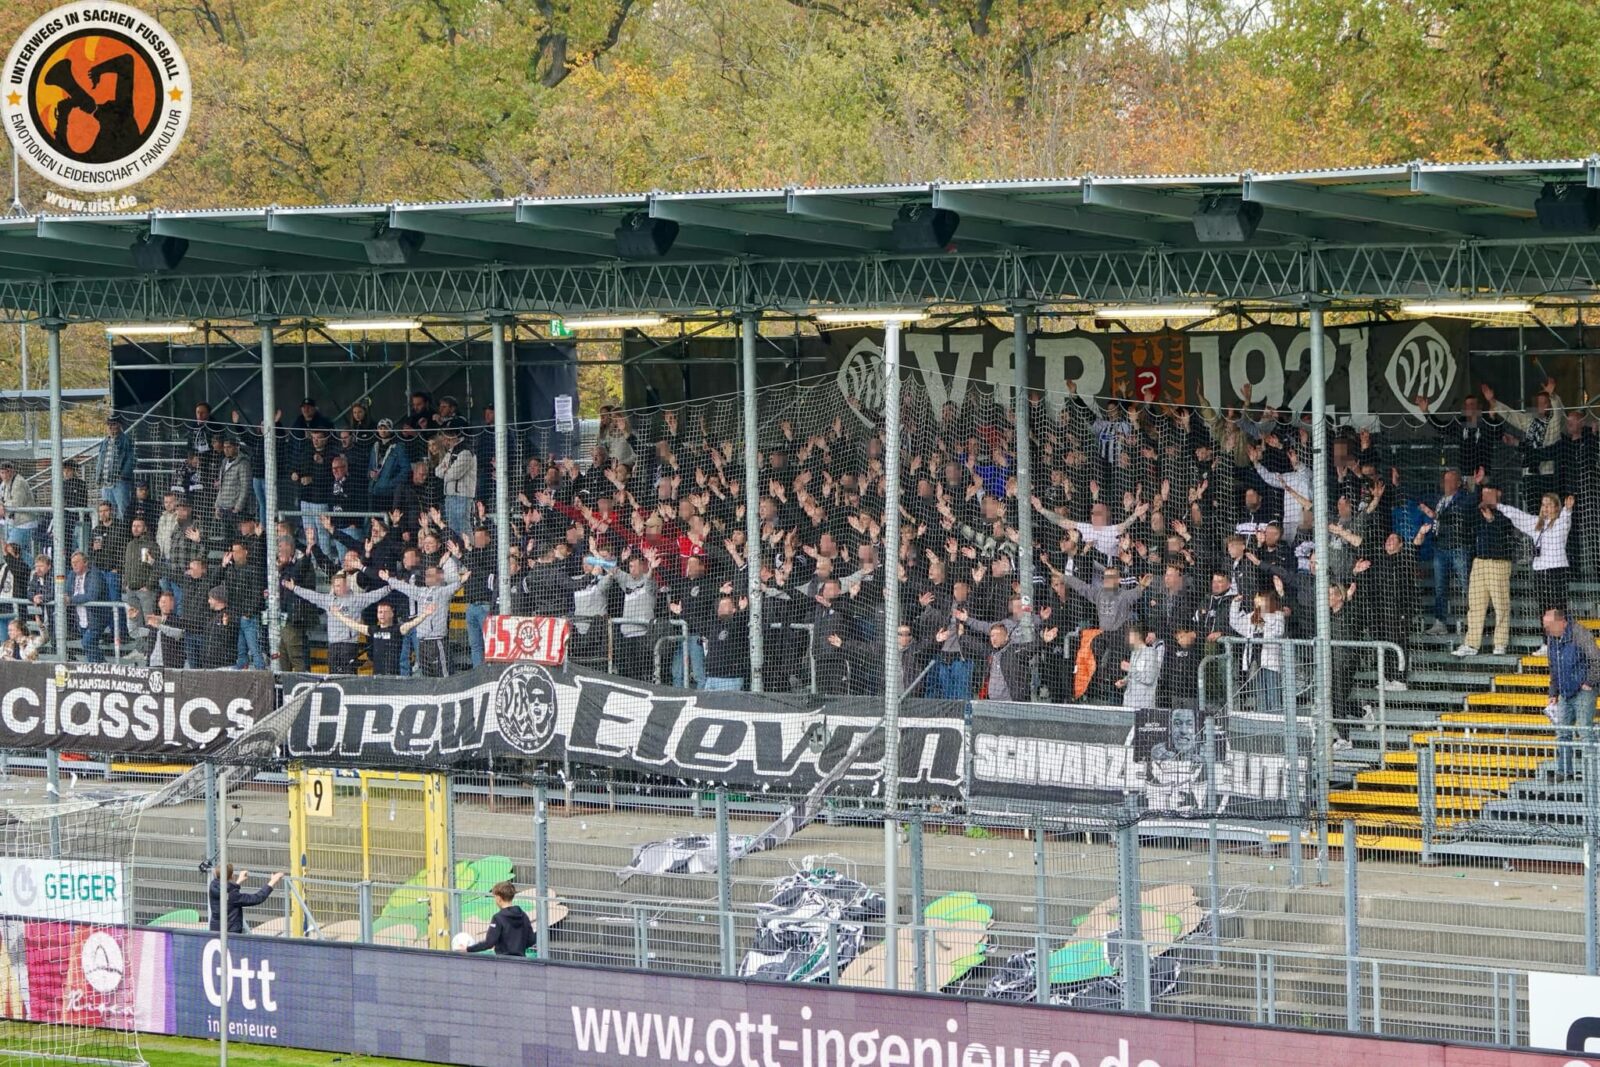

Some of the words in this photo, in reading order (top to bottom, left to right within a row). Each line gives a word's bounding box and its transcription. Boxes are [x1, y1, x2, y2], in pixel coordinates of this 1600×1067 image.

[1190, 327, 1380, 433] 1921
[2, 678, 254, 743] classics
[566, 676, 967, 787] Eleven
[974, 733, 1147, 792] SCHWARZE
[313, 779, 323, 811] 9
[45, 873, 118, 902] GEIGER
[202, 938, 277, 1012] Ott
[207, 1015, 278, 1039] inenieure
